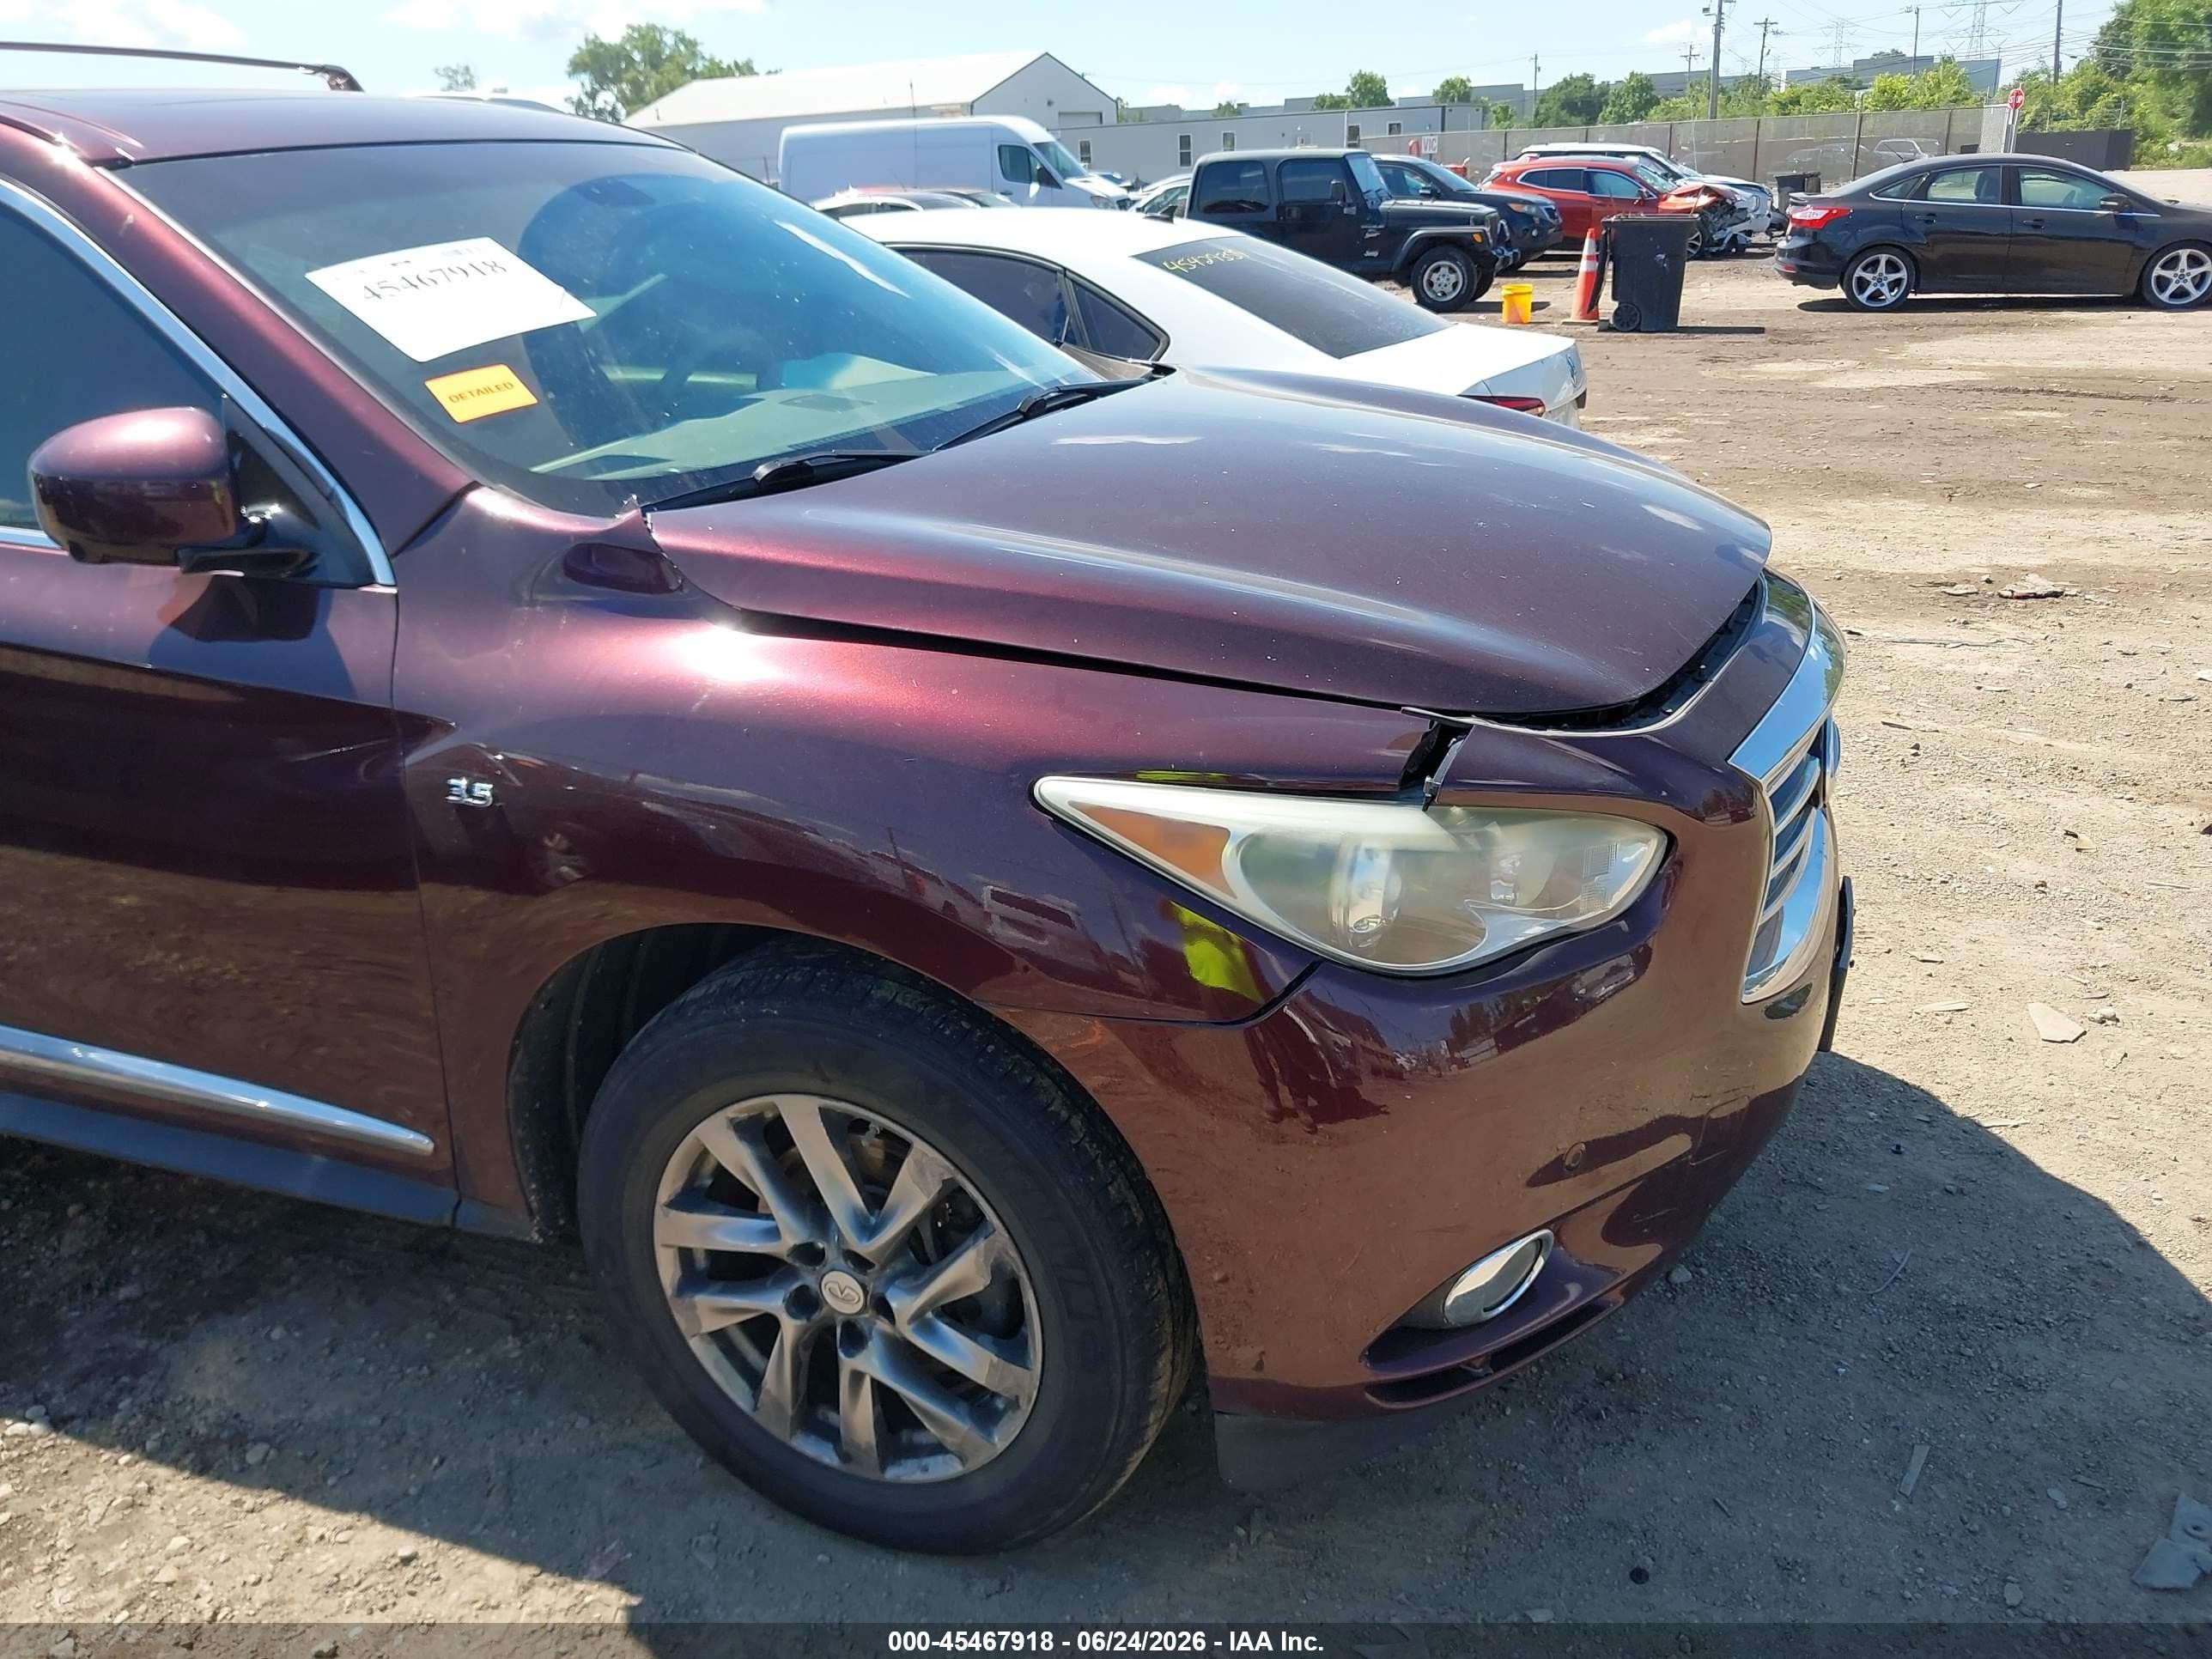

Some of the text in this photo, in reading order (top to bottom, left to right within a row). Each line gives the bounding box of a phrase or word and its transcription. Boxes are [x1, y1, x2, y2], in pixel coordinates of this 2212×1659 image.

[2009, 95, 2023, 104] STOP
[1423, 137, 1437, 152] VIC
[363, 260, 507, 300] 45467918
[448, 381, 515, 404] DETAILED
